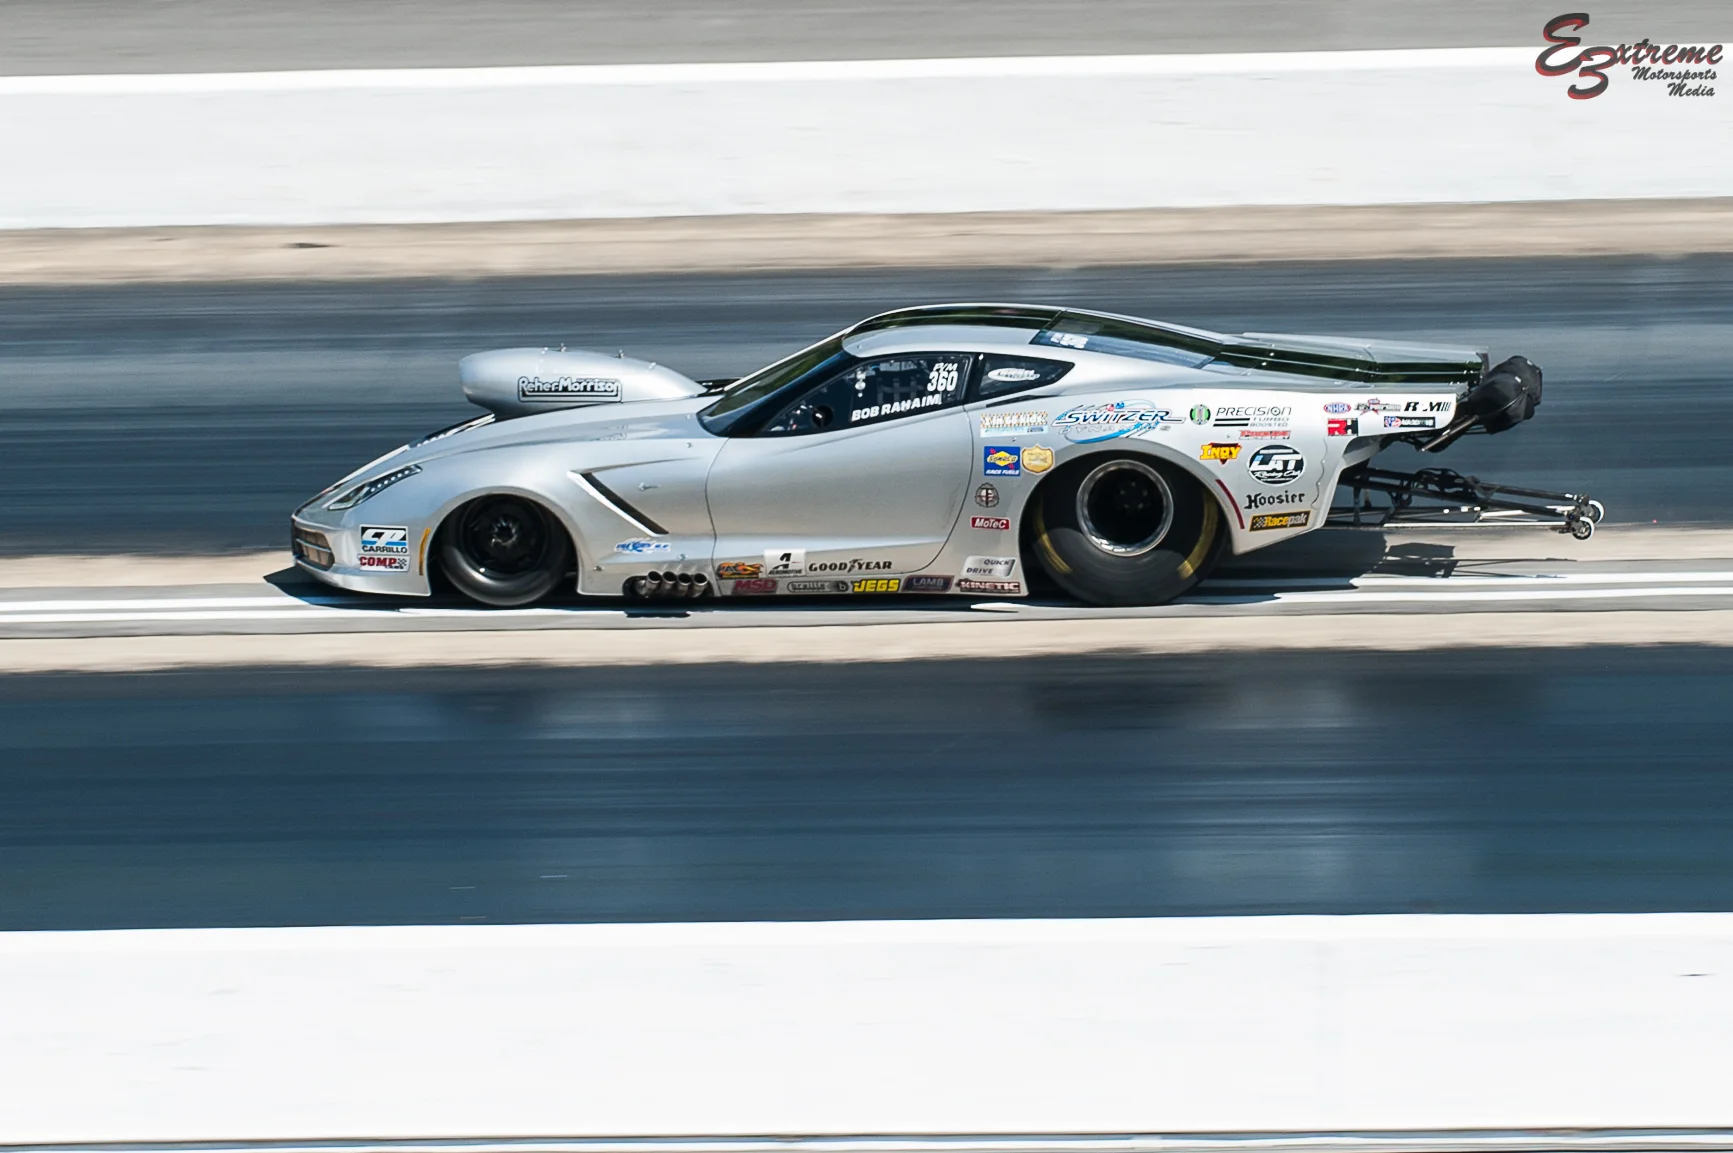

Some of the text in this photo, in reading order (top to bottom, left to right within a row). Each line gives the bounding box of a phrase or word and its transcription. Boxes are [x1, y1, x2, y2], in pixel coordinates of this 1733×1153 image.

[927, 371, 958, 391] 360
[851, 394, 942, 421] BOB RAHAIM
[1216, 406, 1292, 416] PRECISION
[1053, 410, 1185, 426] SWITZER
[1249, 453, 1302, 471] LAT
[1244, 490, 1305, 510] Hoosier
[974, 517, 1007, 529] MoTeC
[1264, 512, 1308, 528] Racepak
[362, 545, 408, 554] CARRILLO
[359, 556, 398, 567] COMP
[733, 579, 777, 591] MSD
[852, 579, 900, 592] JEGS
[960, 580, 1020, 591] KINETIC
